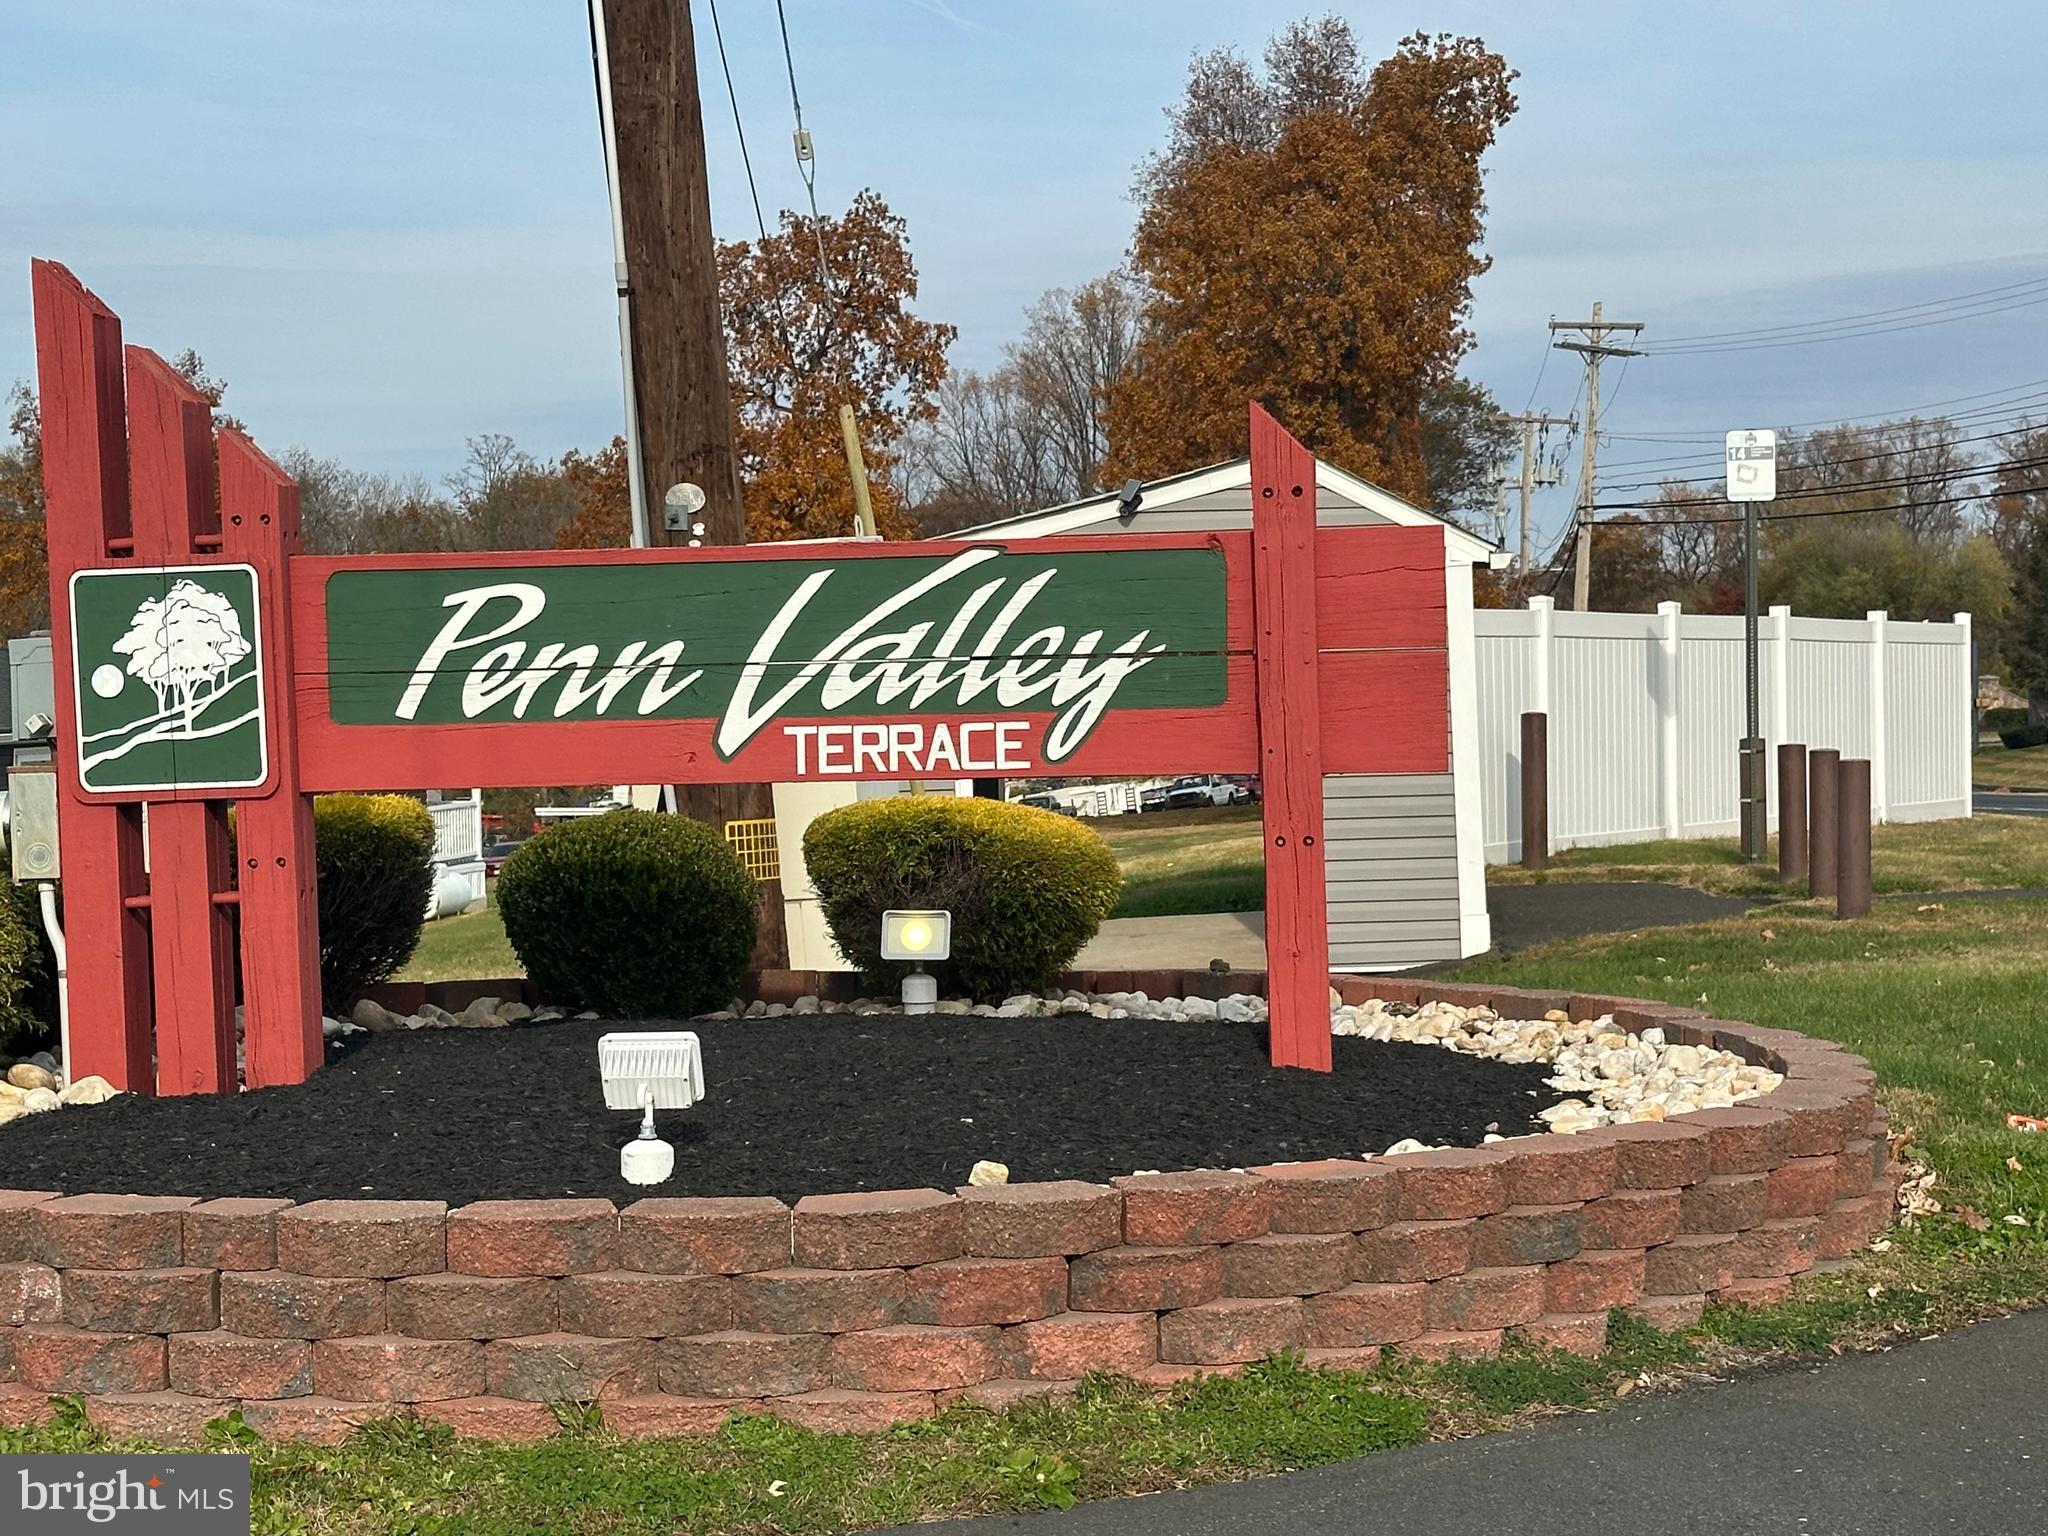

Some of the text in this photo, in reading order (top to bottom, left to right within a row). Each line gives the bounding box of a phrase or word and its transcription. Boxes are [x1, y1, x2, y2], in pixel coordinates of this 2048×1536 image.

[1729, 447, 1746, 460] 14
[396, 547, 1167, 760] Penn Valley
[784, 721, 1033, 777] TERRACE
